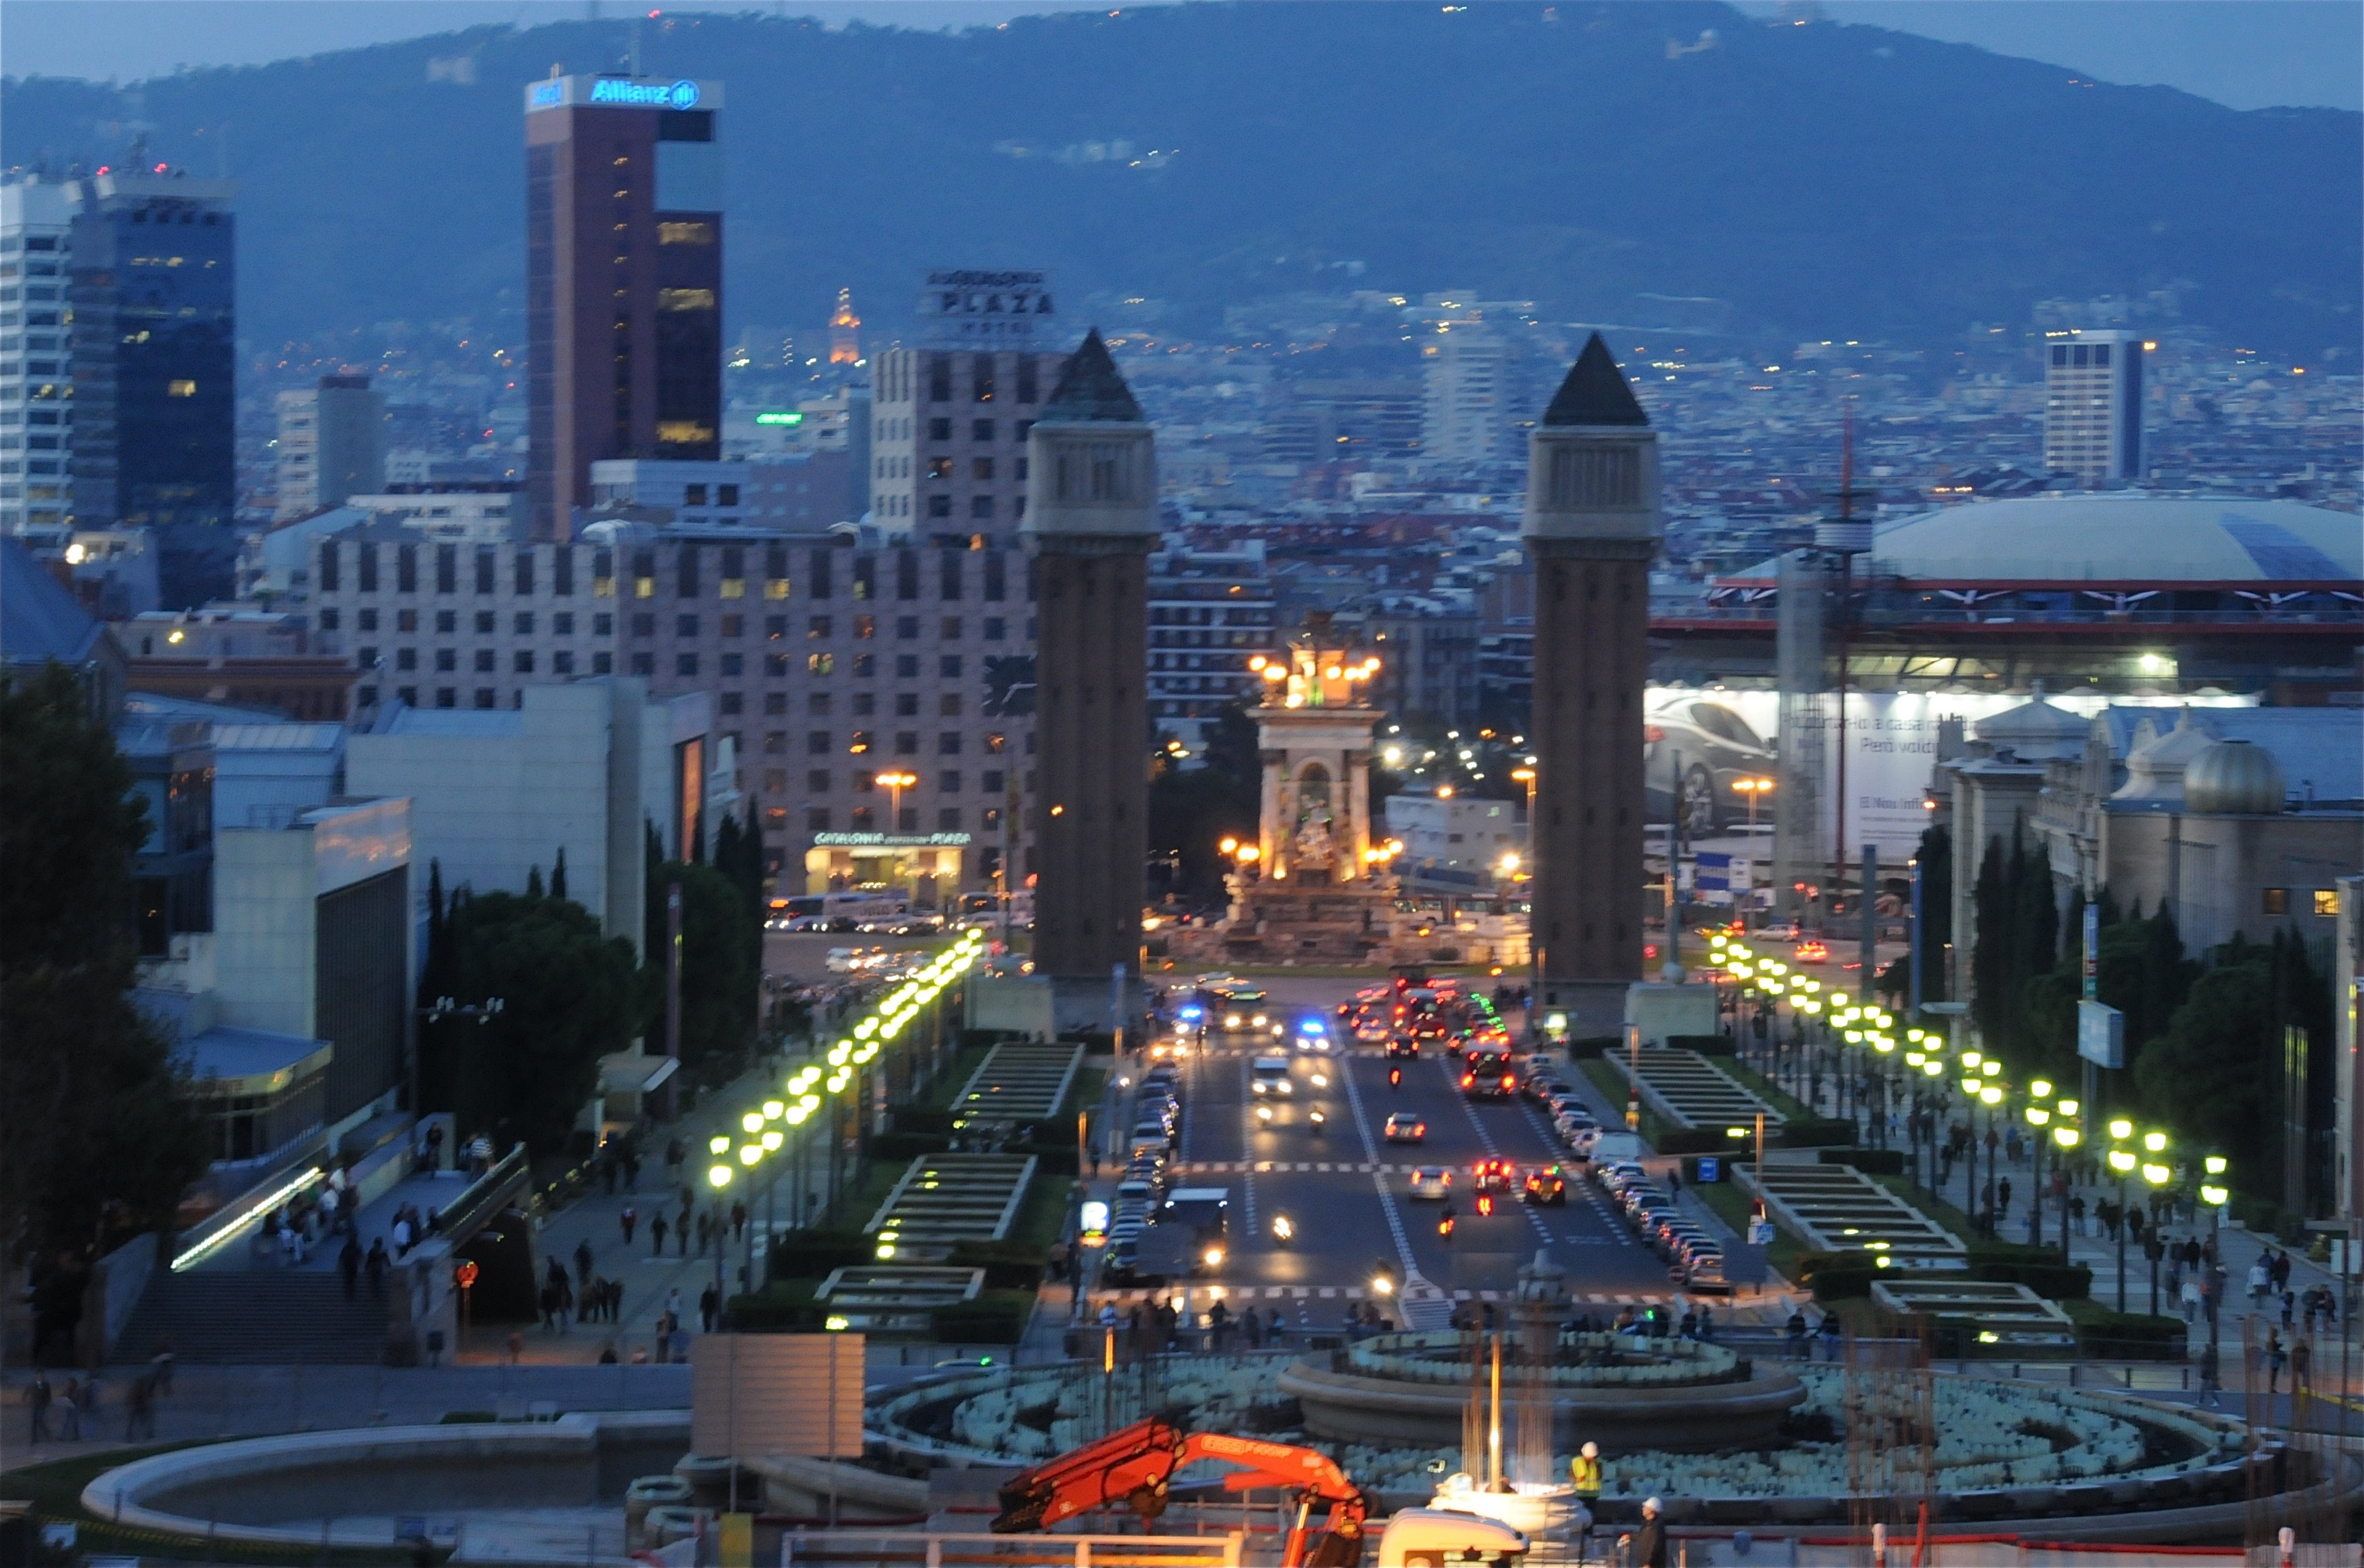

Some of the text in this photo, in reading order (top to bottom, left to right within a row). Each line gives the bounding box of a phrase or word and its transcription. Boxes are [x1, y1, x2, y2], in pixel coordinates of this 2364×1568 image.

[591, 80, 670, 103] Allianz
[941, 293, 1053, 314] PLAZA
[815, 832, 884, 846] CATALONIA
[930, 833, 971, 845] PLAZA
